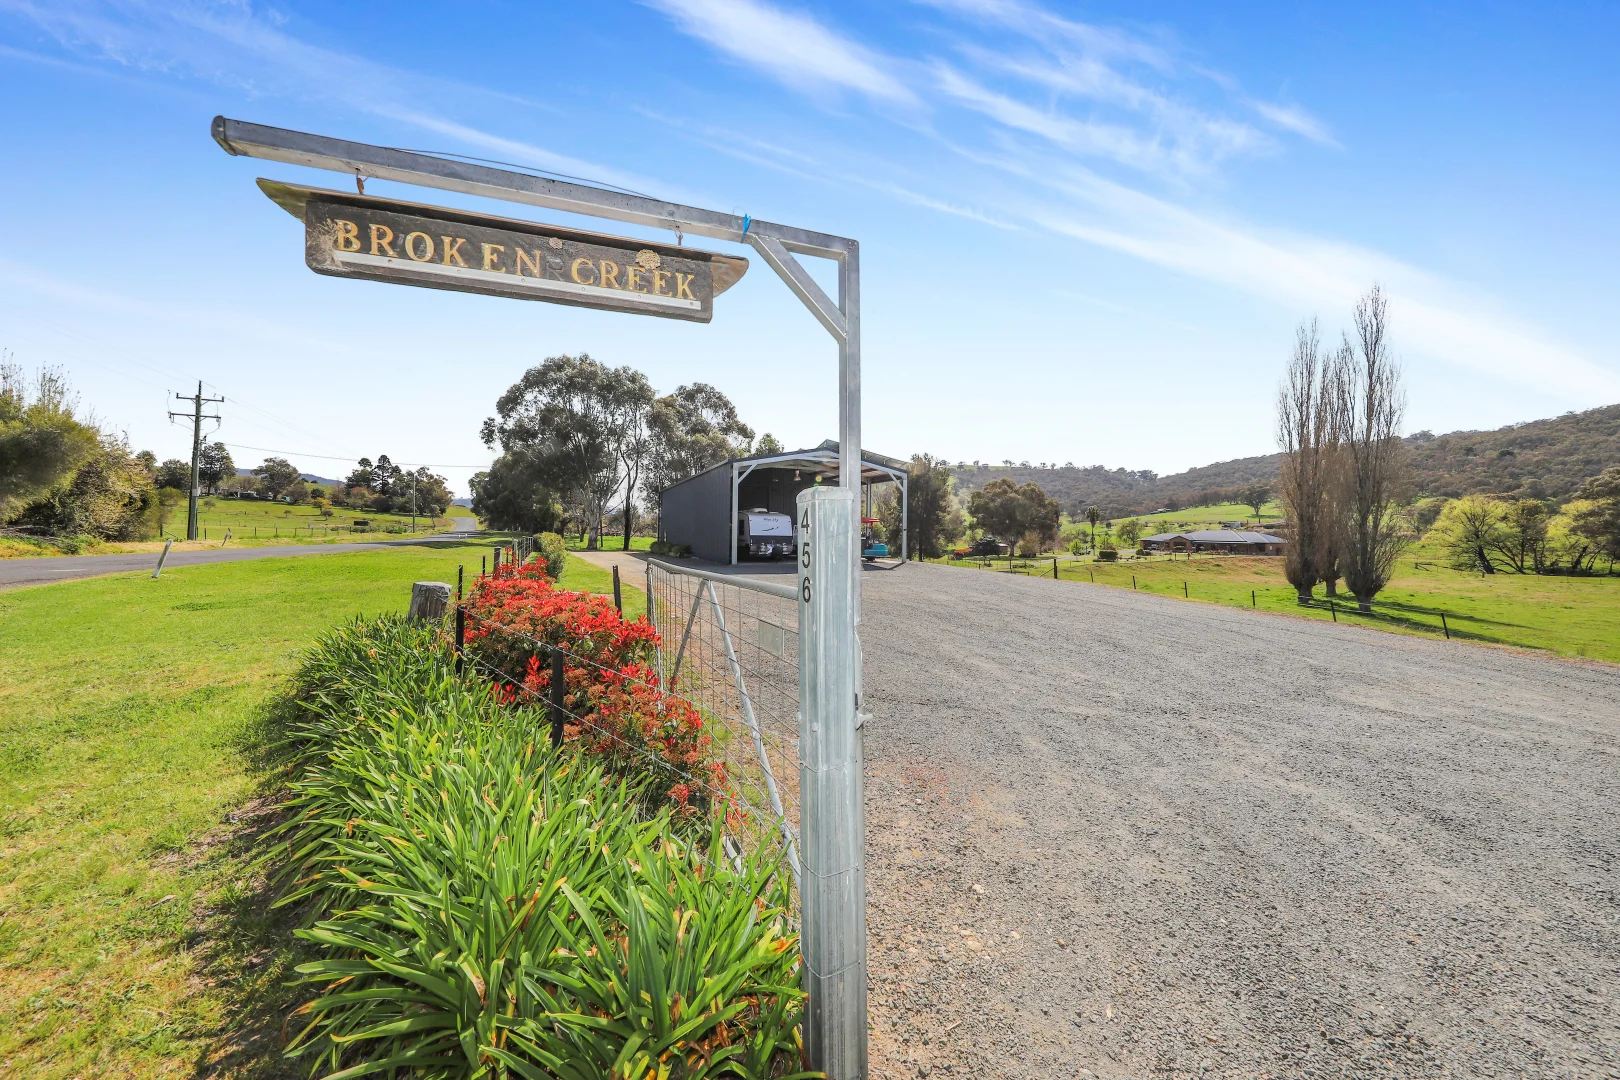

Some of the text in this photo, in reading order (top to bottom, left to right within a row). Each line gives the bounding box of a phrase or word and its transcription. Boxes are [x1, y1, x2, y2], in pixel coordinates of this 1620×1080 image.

[334, 219, 697, 301] BROKEN CREEK
[800, 507, 811, 603] 456
